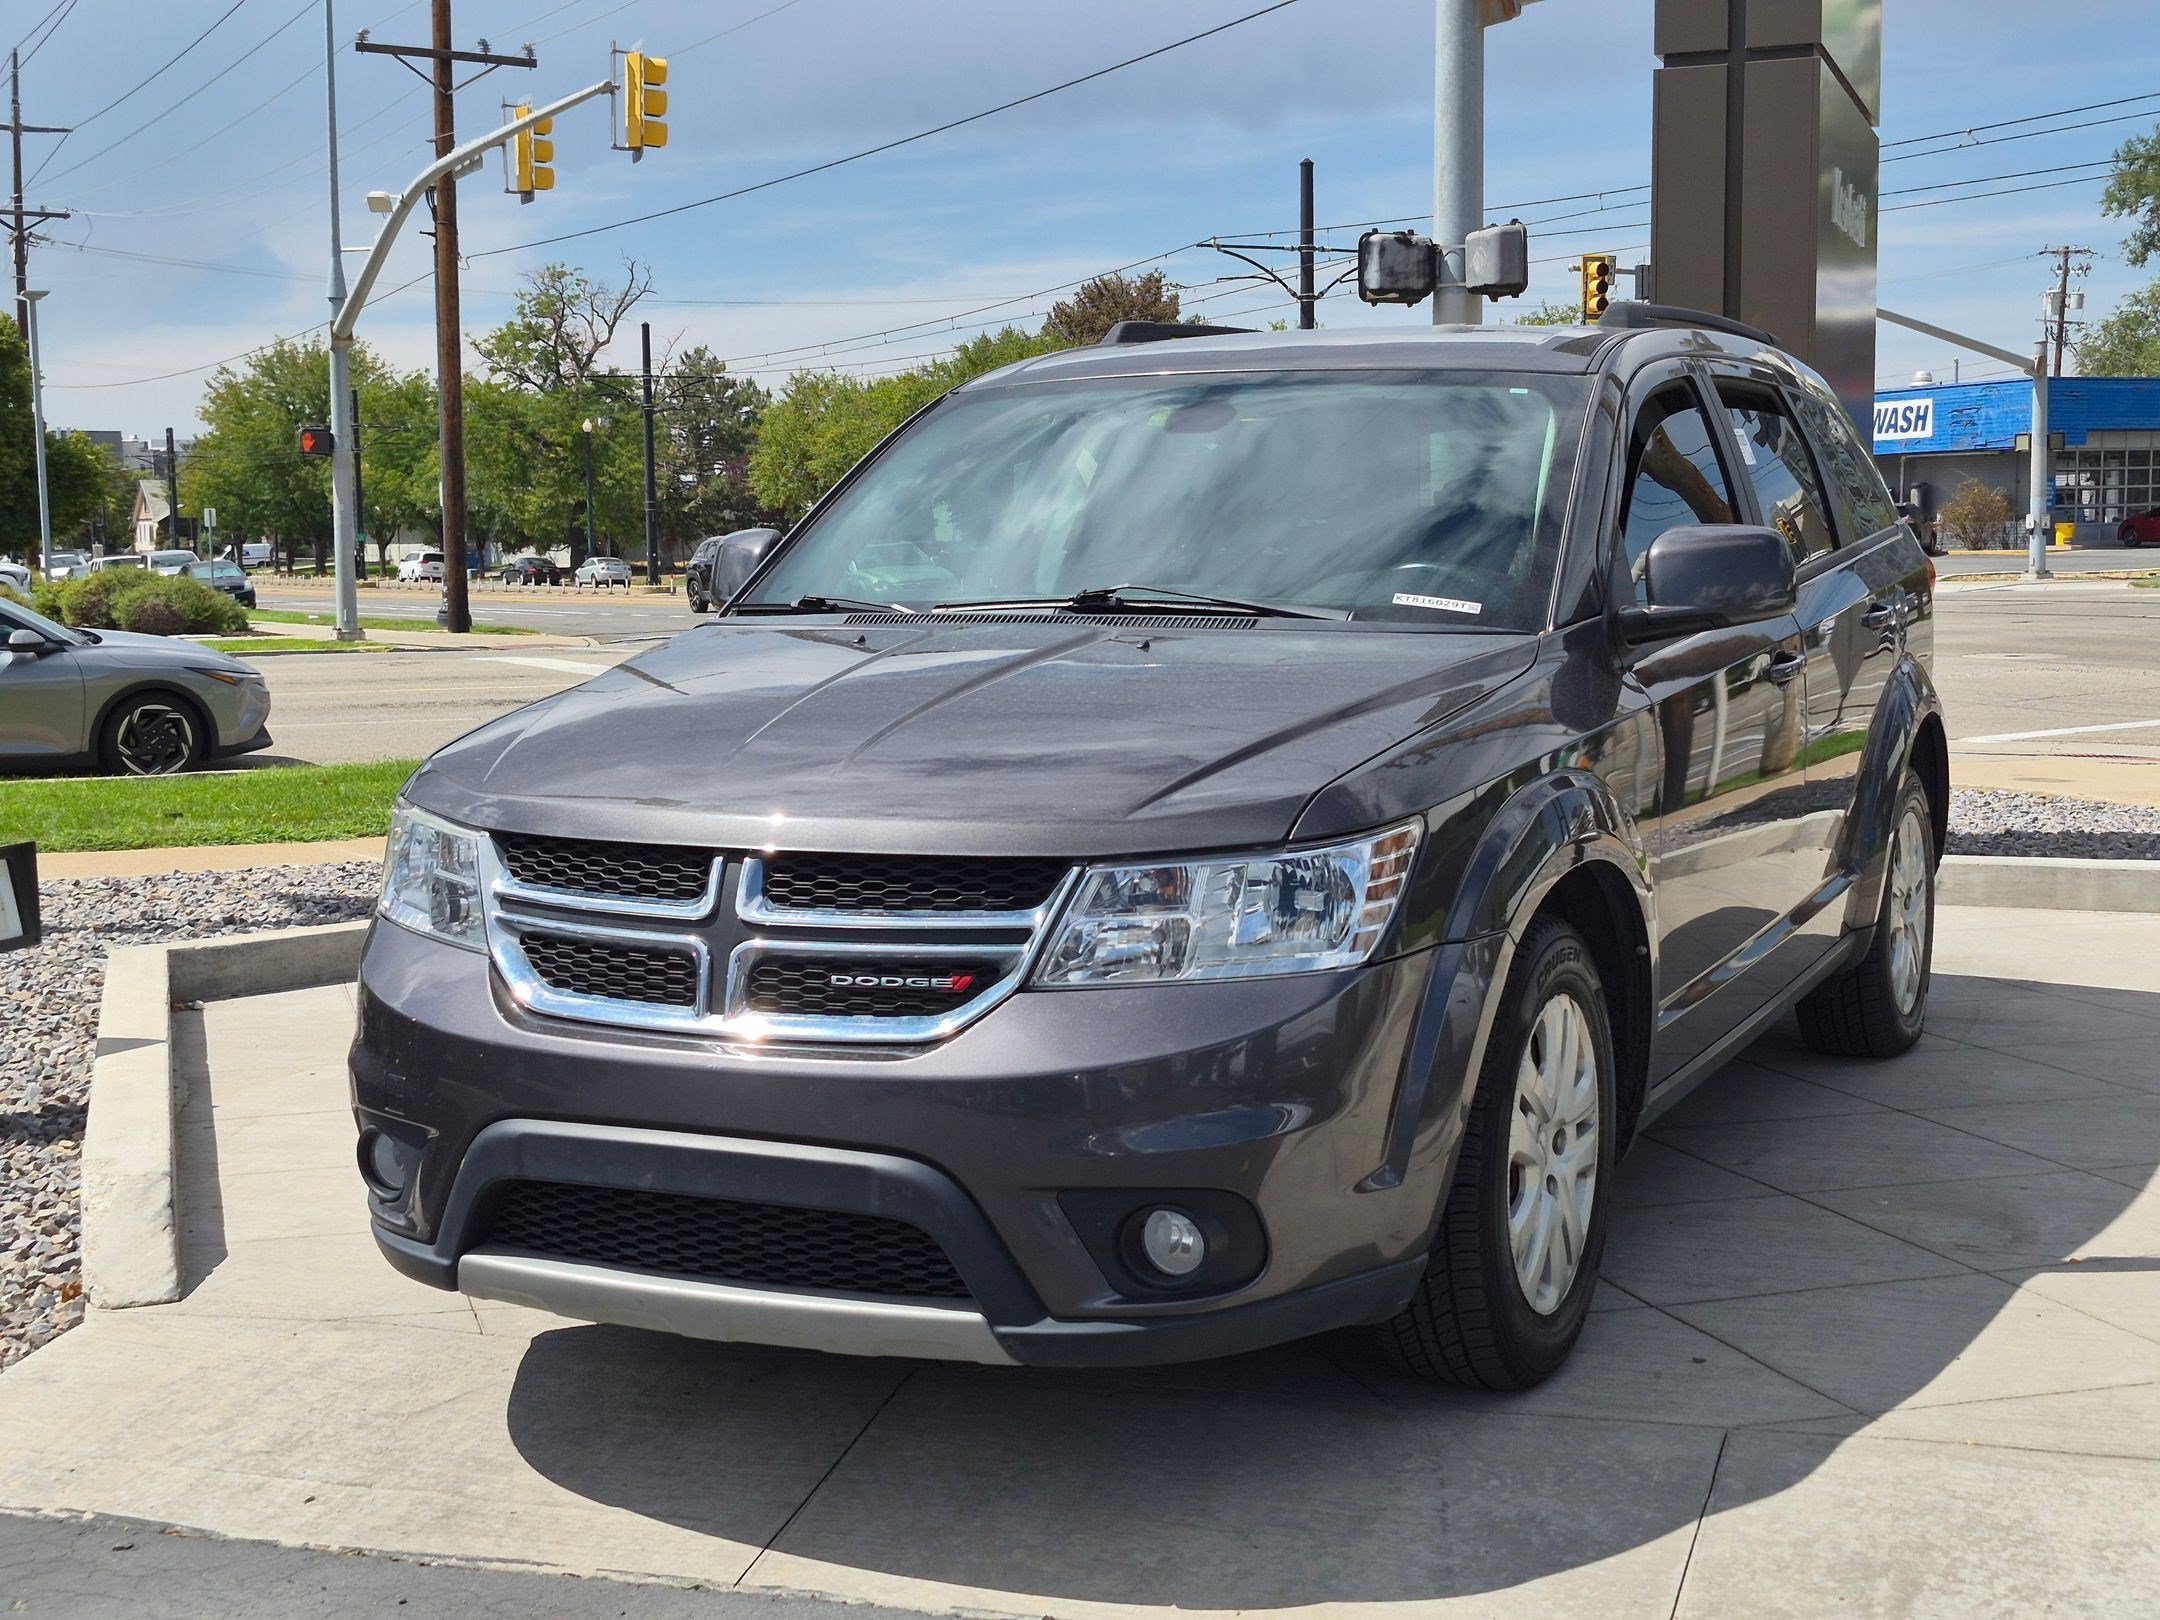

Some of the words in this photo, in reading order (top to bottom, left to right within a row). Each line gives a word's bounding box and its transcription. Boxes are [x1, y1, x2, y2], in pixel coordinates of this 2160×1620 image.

[1874, 405, 1929, 434] WASH
[1395, 595, 1468, 609] KT816029T
[1537, 945, 1582, 995] CRUGEN
[830, 974, 954, 988] DODGE
